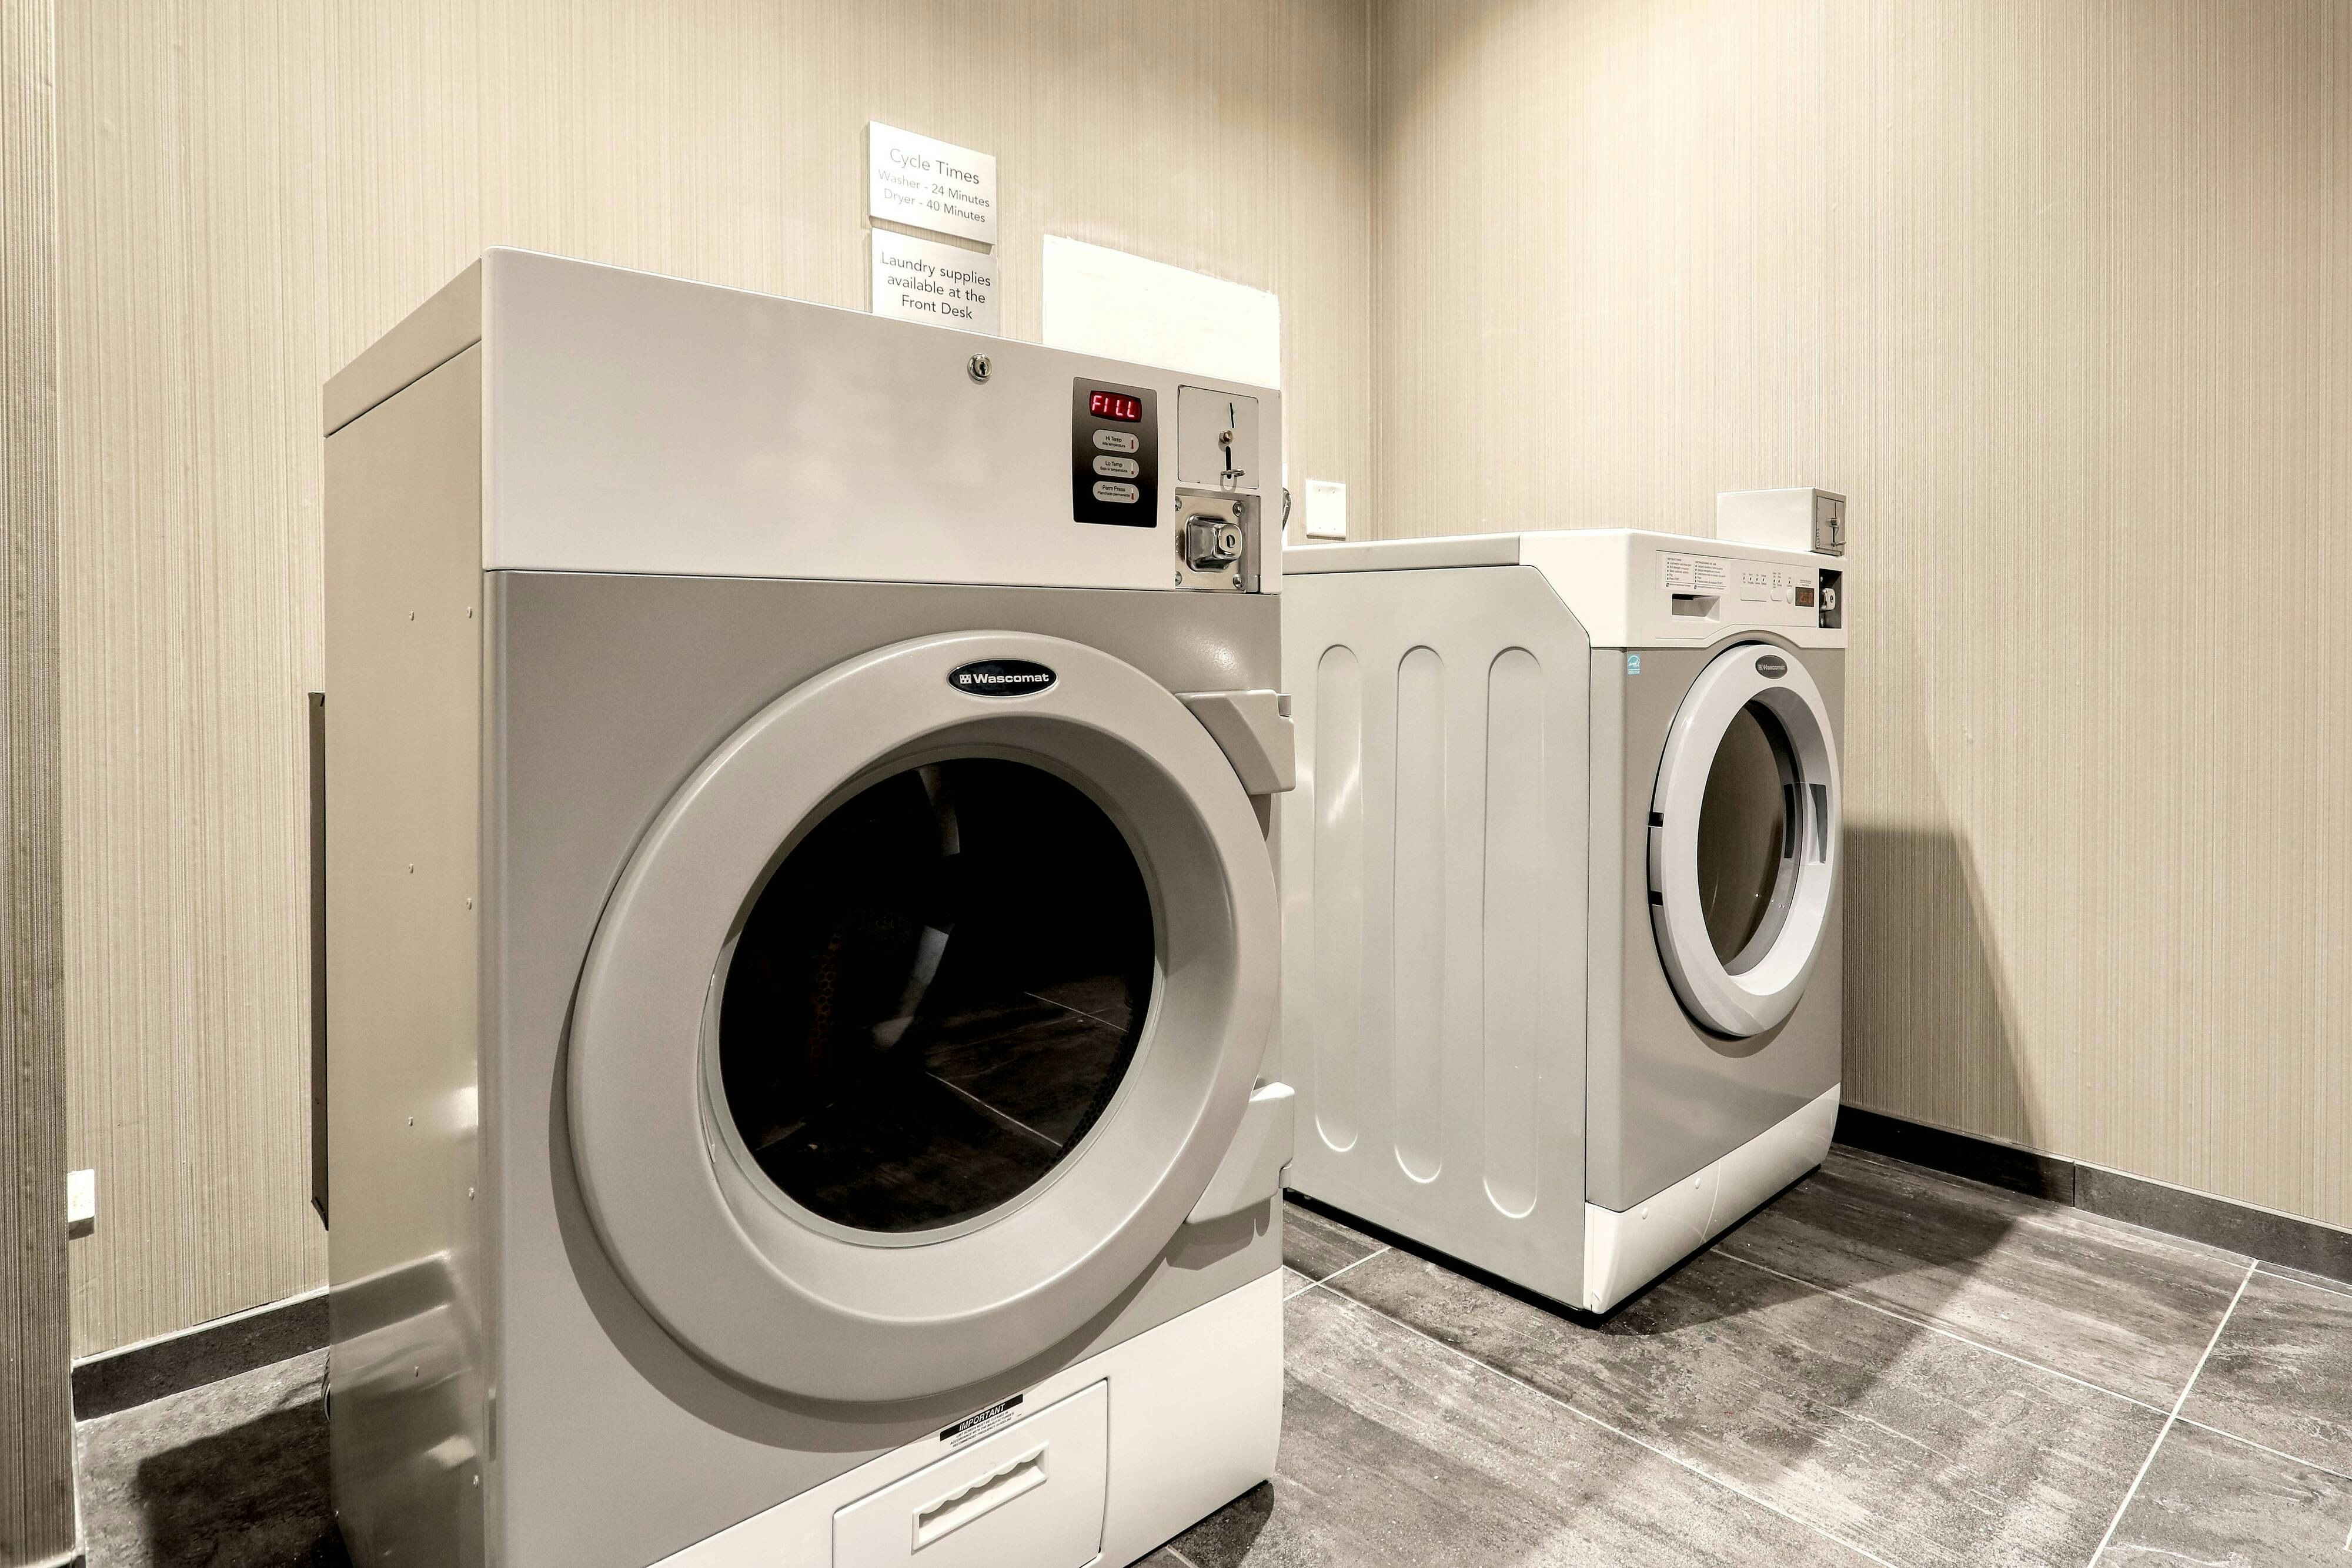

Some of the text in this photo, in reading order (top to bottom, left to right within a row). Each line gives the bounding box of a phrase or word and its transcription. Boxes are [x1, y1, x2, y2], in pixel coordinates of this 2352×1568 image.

[889, 148, 980, 184] Cycle Times
[878, 169, 921, 190] Washer
[931, 183, 945, 196] 24
[948, 188, 990, 208] Minutes
[884, 188, 916, 206] Dryer
[926, 199, 940, 212] 40
[944, 203, 985, 223] Minutes
[881, 252, 991, 287] Laundry supplies
[887, 275, 985, 304] available at the
[901, 295, 973, 320] Front Desk
[1092, 395, 1135, 418] FILL
[973, 673, 1050, 684] Wascomat
[959, 1403, 1006, 1432] IMPORTANT
